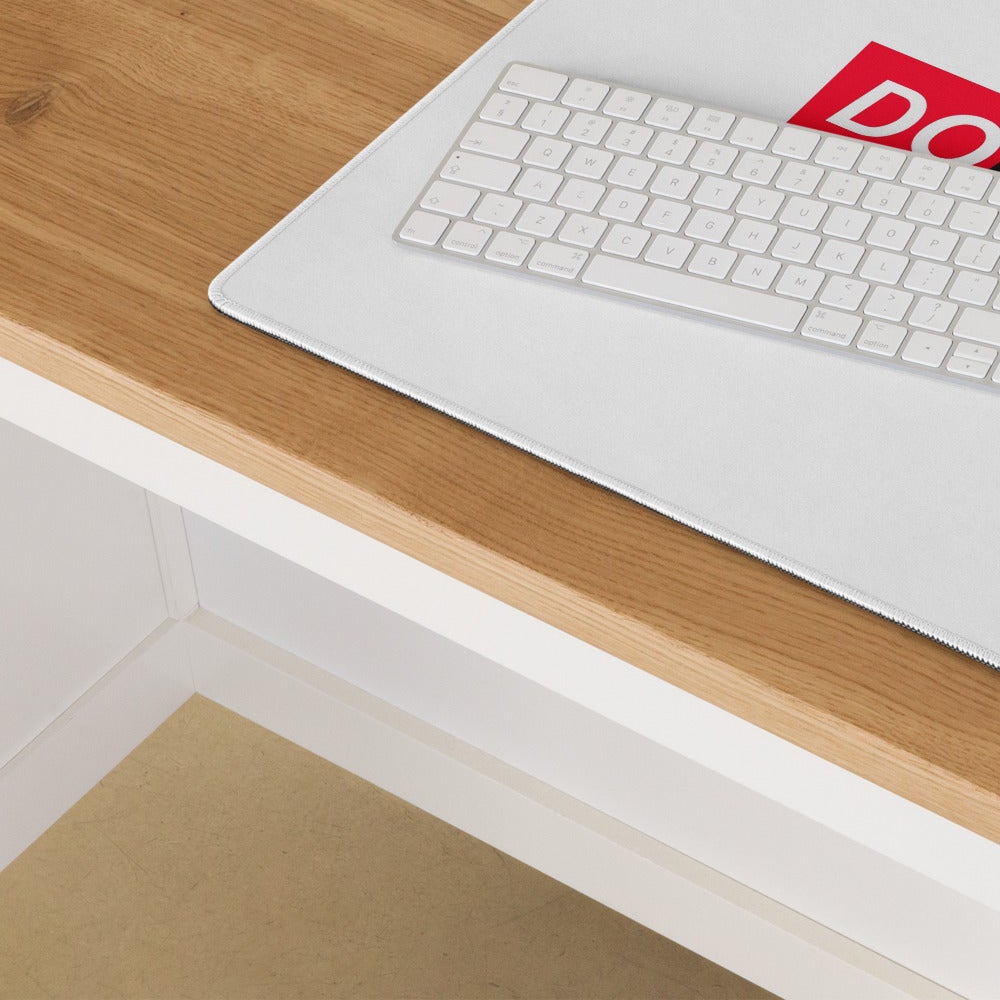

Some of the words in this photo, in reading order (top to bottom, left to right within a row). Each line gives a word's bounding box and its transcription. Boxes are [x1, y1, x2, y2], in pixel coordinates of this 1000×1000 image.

[532, 180, 542, 190] A
[618, 200, 629, 209] D
[661, 210, 672, 219] F
[704, 220, 716, 230] G
[747, 231, 760, 240] H
[791, 242, 801, 250] J
[835, 251, 845, 261] K
[879, 262, 886, 272] L
[542, 147, 553, 158] Q
[584, 157, 598, 167] W
[627, 168, 637, 177] E
[669, 178, 680, 187] R
[714, 188, 724, 197] T
[757, 197, 767, 207] Y
[799, 208, 810, 217] U
[886, 228, 897, 238] O
[929, 239, 940, 247] P
[450, 240, 478, 250] control
[494, 251, 519, 261] option
[536, 261, 574, 273] command
[807, 327, 846, 340] command
[863, 340, 889, 350] option
[535, 215, 546, 225] Z
[577, 224, 589, 235] X
[621, 235, 632, 245] C
[666, 246, 676, 256] V
[707, 256, 718, 266] B
[751, 267, 763, 277] N
[794, 277, 808, 287] M
